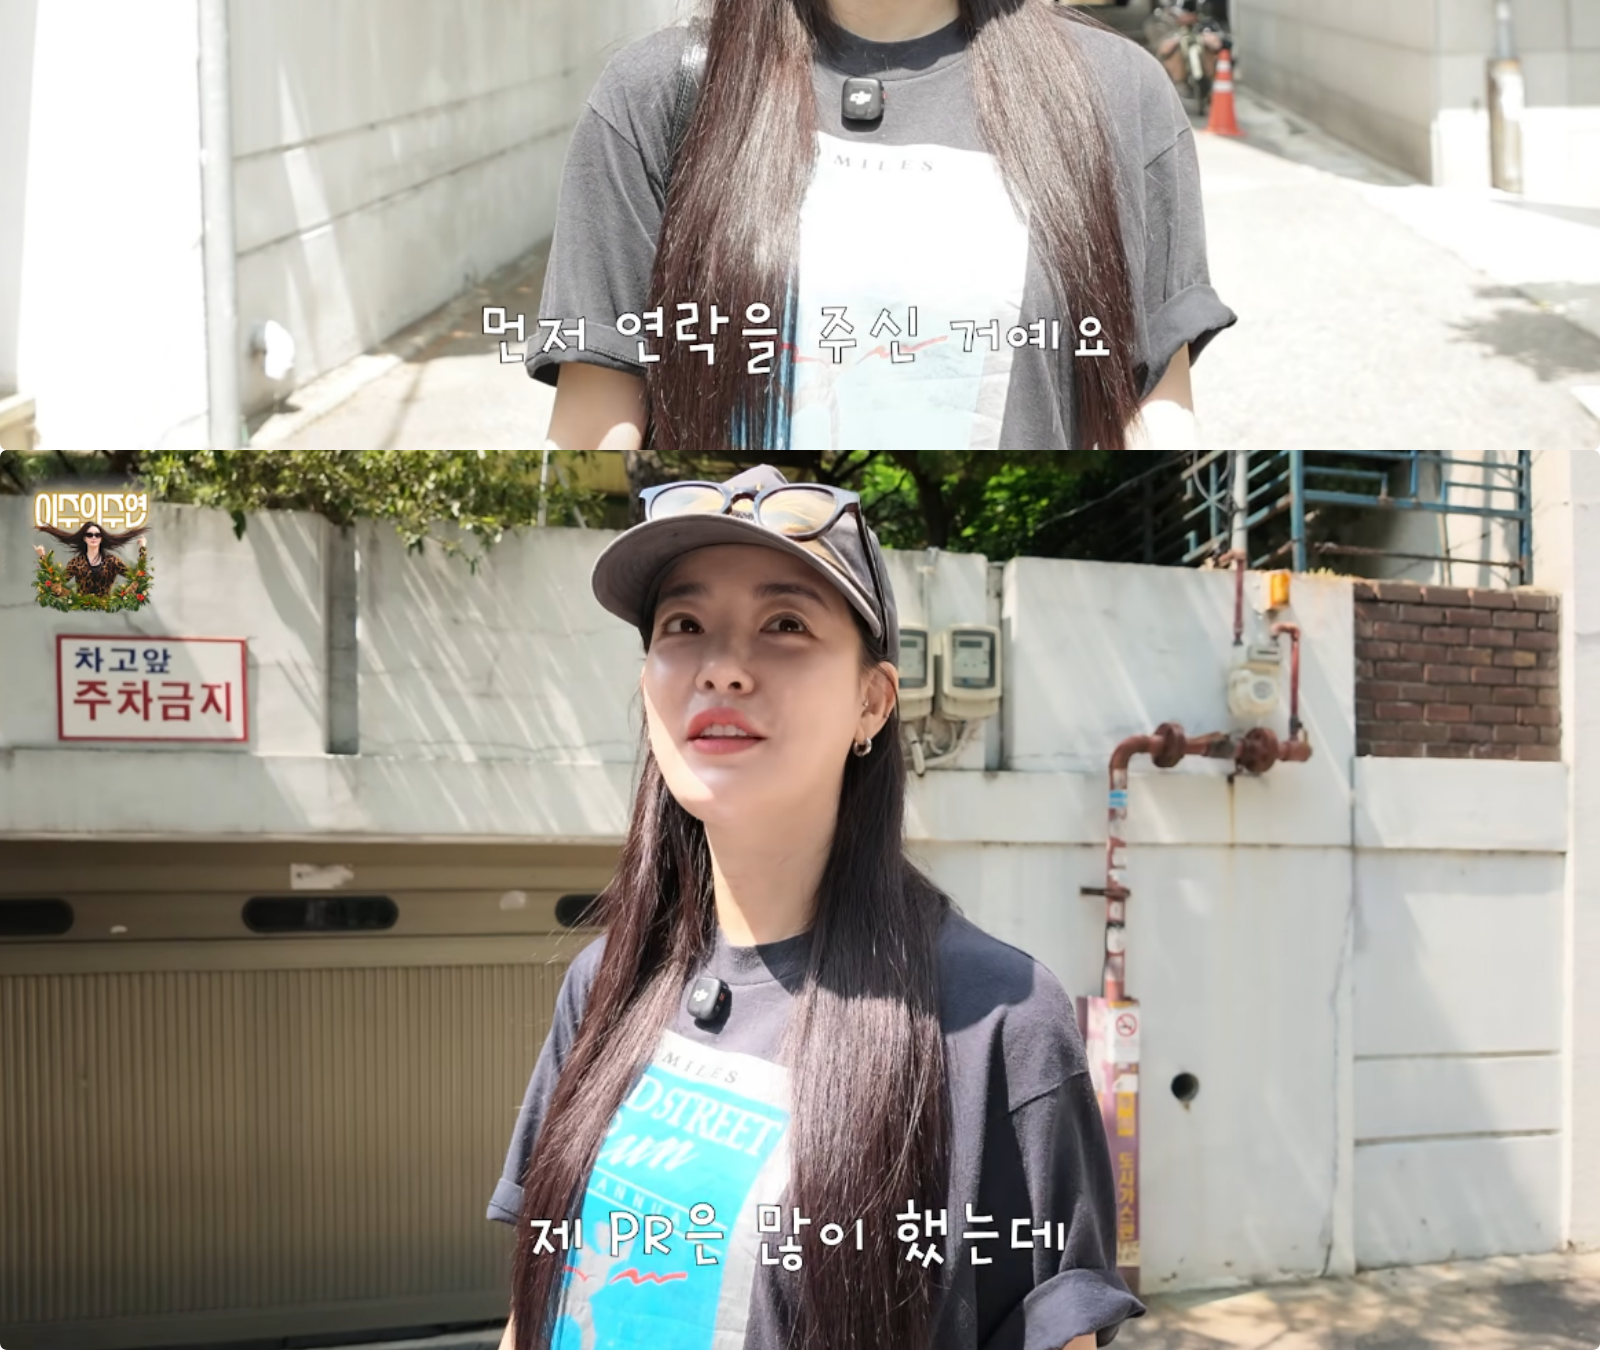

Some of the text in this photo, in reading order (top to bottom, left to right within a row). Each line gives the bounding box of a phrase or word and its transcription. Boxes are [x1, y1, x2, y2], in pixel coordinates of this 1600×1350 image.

[74, 646, 172, 674] 차고앞
[73, 679, 232, 723] 주차금지
[661, 1051, 739, 1084] MILES
